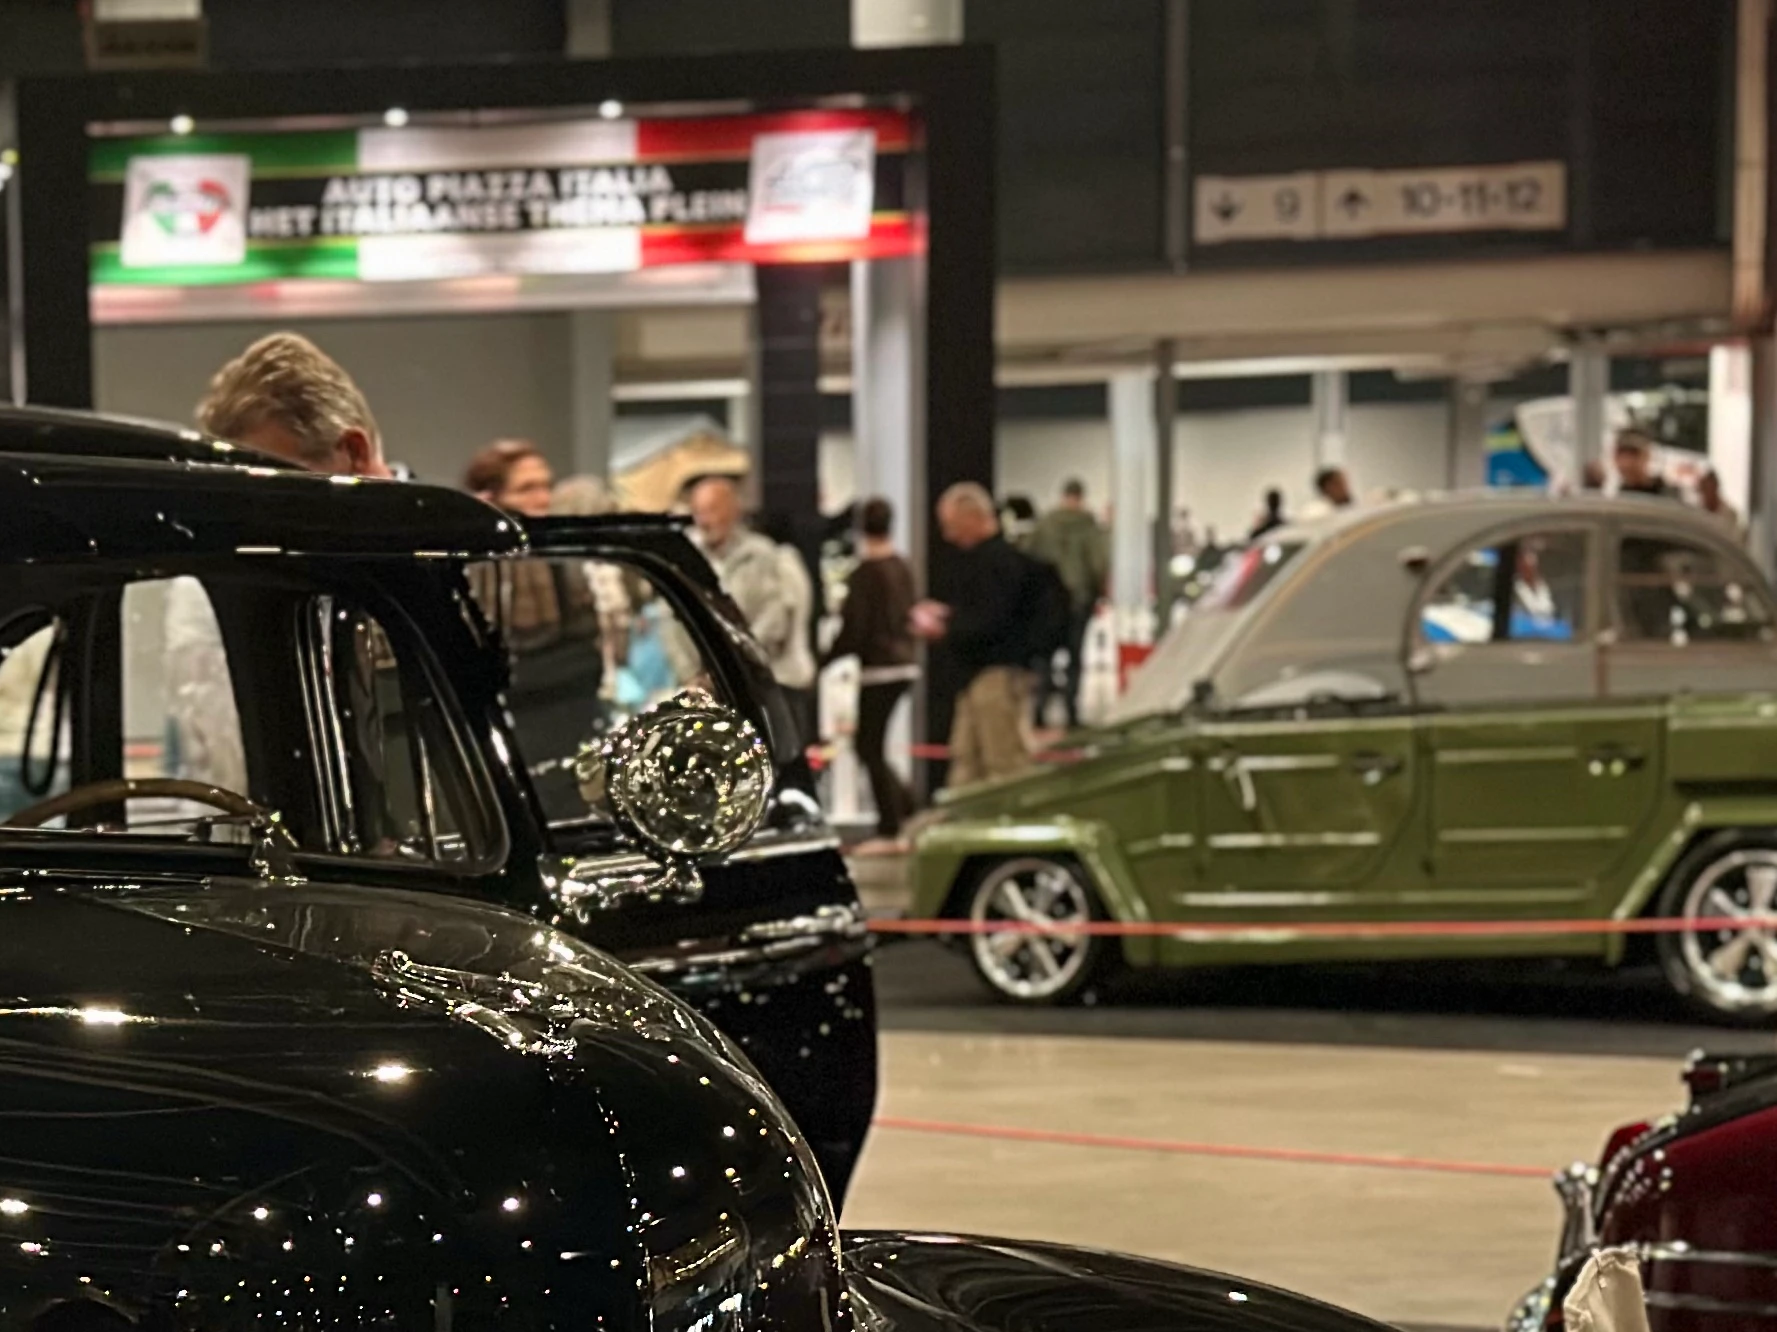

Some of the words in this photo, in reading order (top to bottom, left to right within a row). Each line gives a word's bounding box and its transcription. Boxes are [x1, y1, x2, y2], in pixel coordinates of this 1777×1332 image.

[322, 173, 423, 204] AUTO
[426, 169, 555, 201] PIAZZA
[558, 165, 674, 197] ITALIA
[250, 204, 315, 237] HET
[527, 193, 646, 228] THEMA
[649, 188, 749, 223] PLEIN
[1274, 187, 1301, 225] 9
